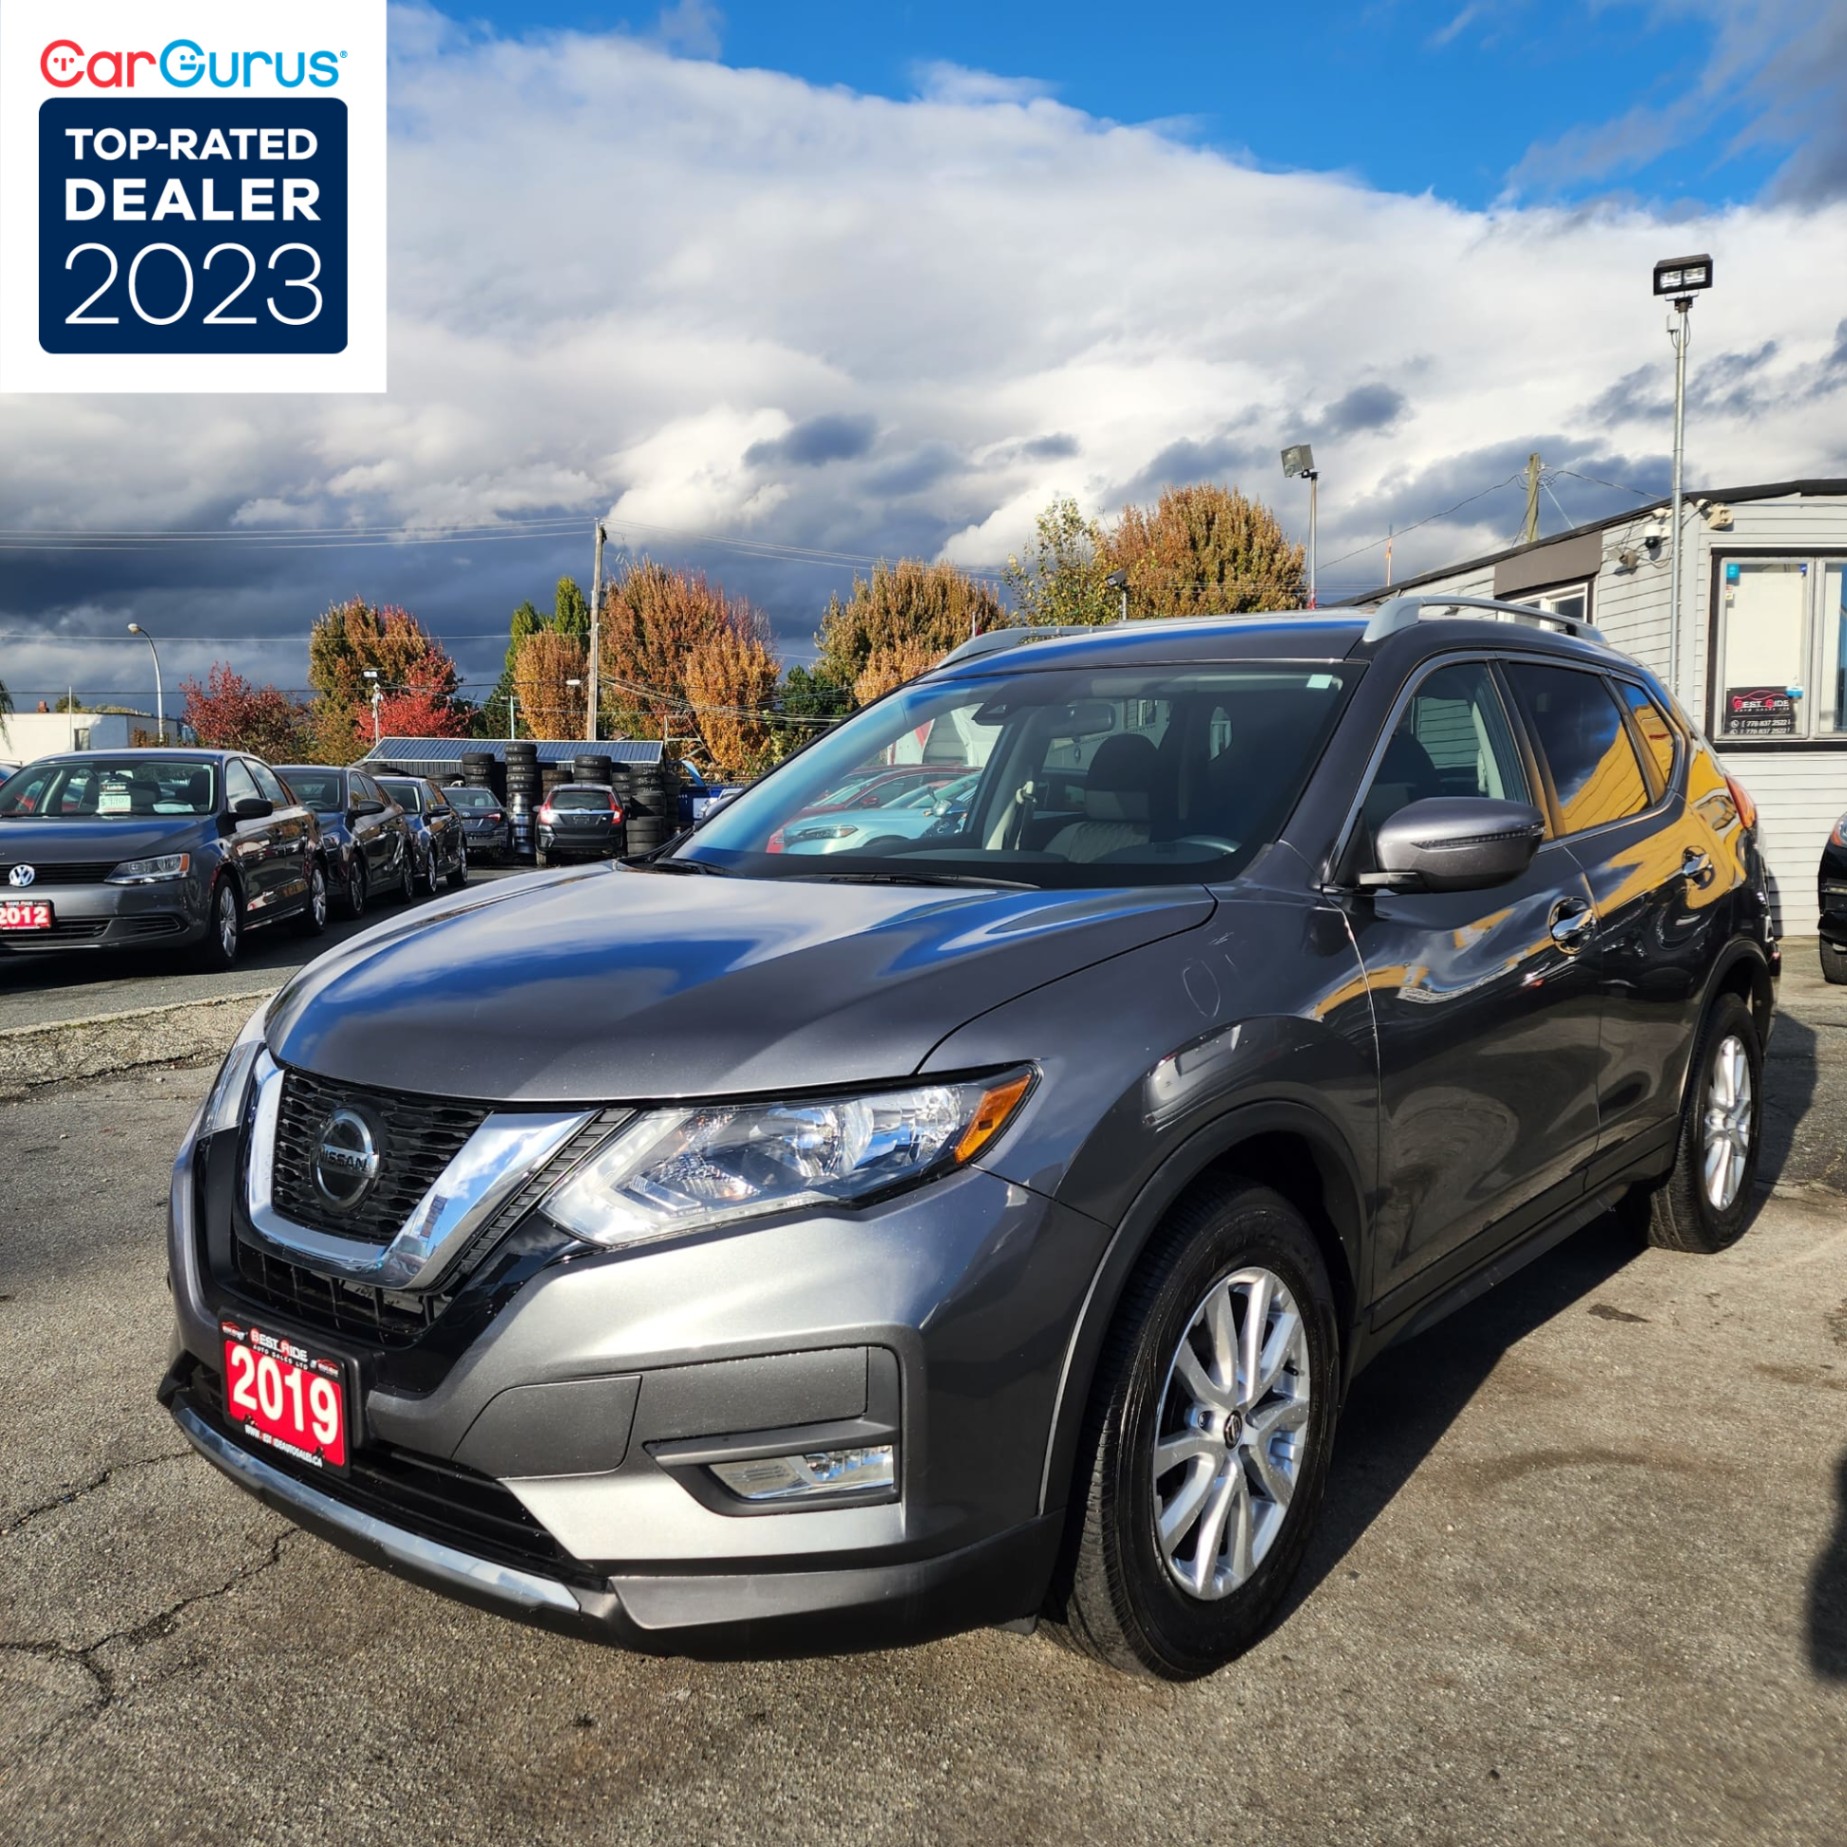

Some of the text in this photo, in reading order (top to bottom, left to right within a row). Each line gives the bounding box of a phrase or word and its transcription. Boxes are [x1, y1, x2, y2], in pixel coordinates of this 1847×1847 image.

[319, 1147, 367, 1172] NISSAN
[250, 1327, 280, 1351] BEST
[280, 1339, 308, 1362] RIDE
[253, 1344, 269, 1355] AUTO
[271, 1351, 293, 1365] SALES
[231, 1344, 338, 1445] 2019
